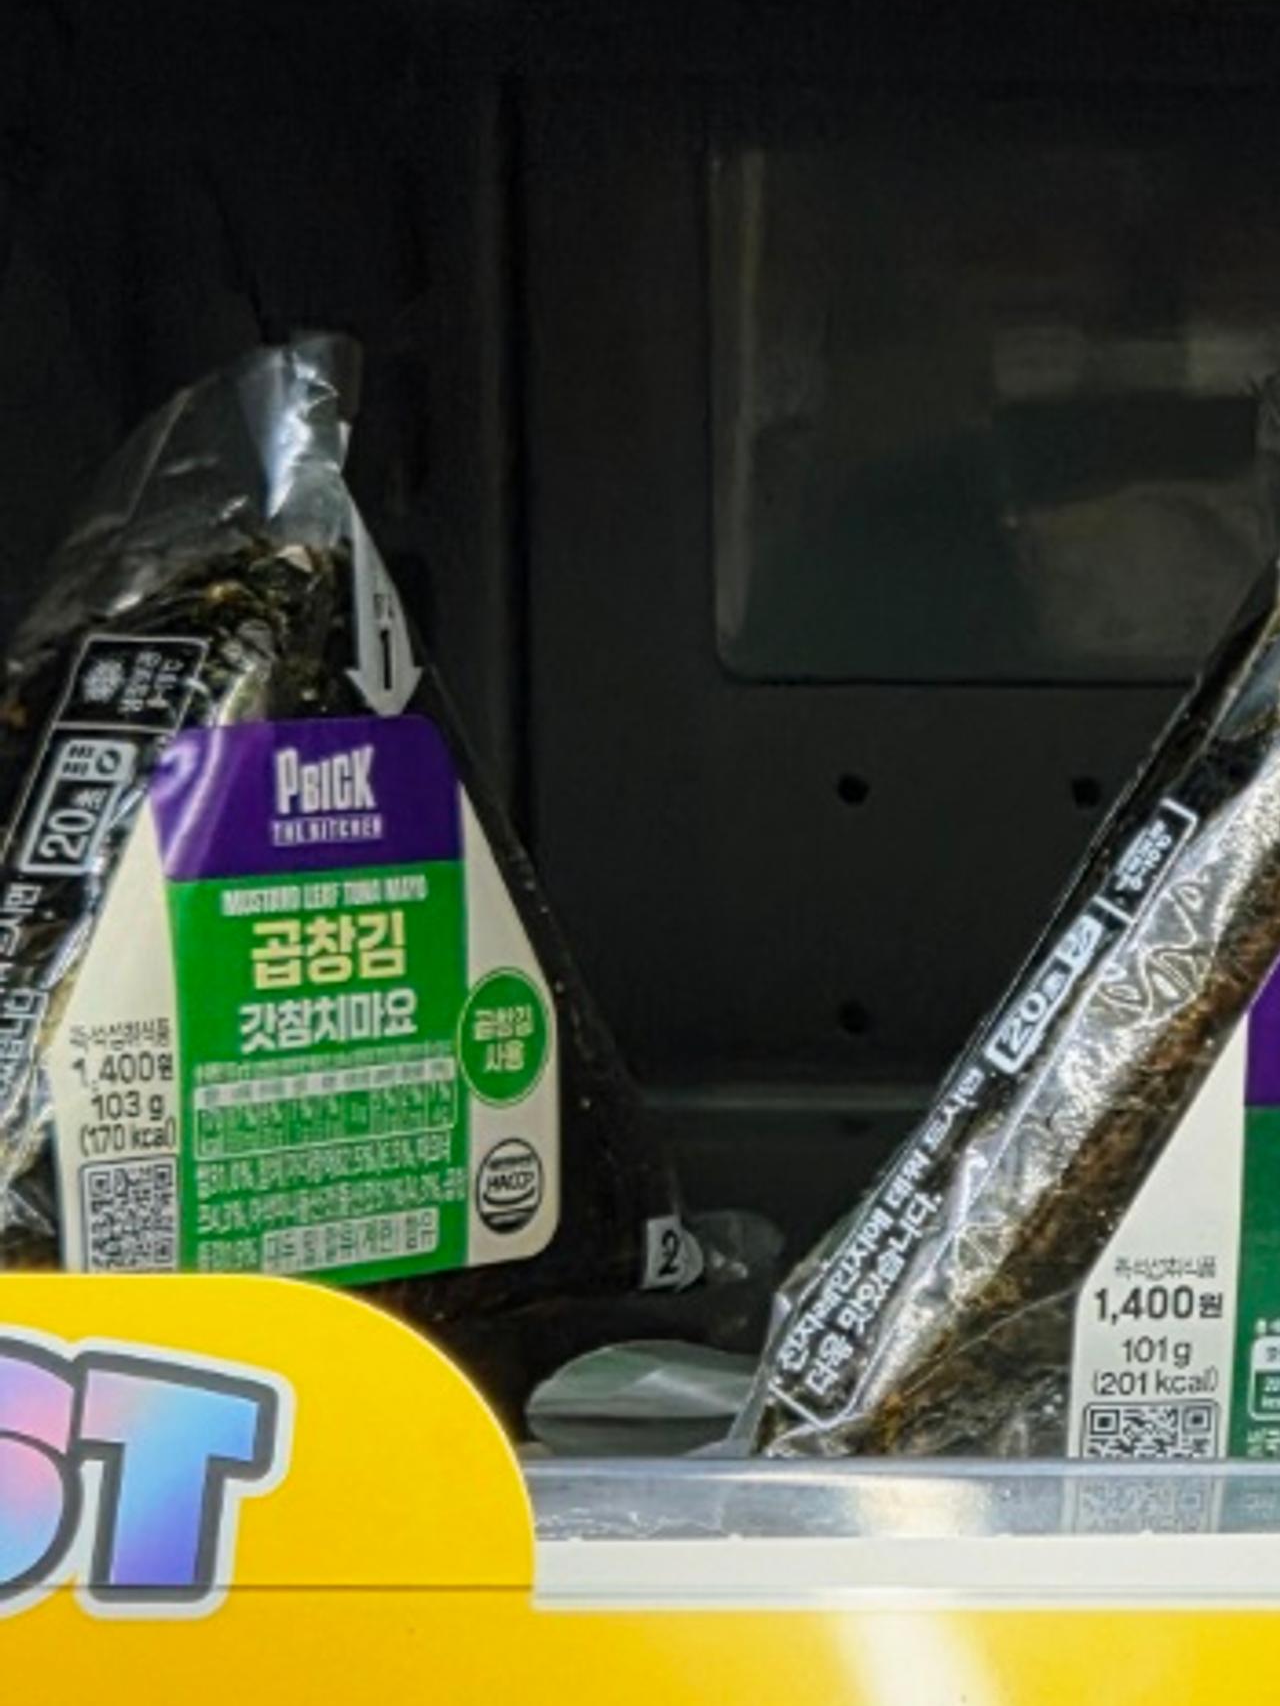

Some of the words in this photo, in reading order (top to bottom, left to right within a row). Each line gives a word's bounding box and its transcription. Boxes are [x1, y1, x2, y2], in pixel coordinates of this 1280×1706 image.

[273, 744, 377, 815] PBICK
[251, 910, 407, 990] 곱창김
[239, 989, 418, 1053] 갓참치마요
[91, 1094, 141, 1120] 103
[657, 1235, 682, 1276] 2
[1094, 1284, 1224, 1323] 1,400원
[1121, 1335, 1169, 1364] 101
[1092, 1369, 1150, 1398] (201
[1153, 1367, 1220, 1396] kcal)
